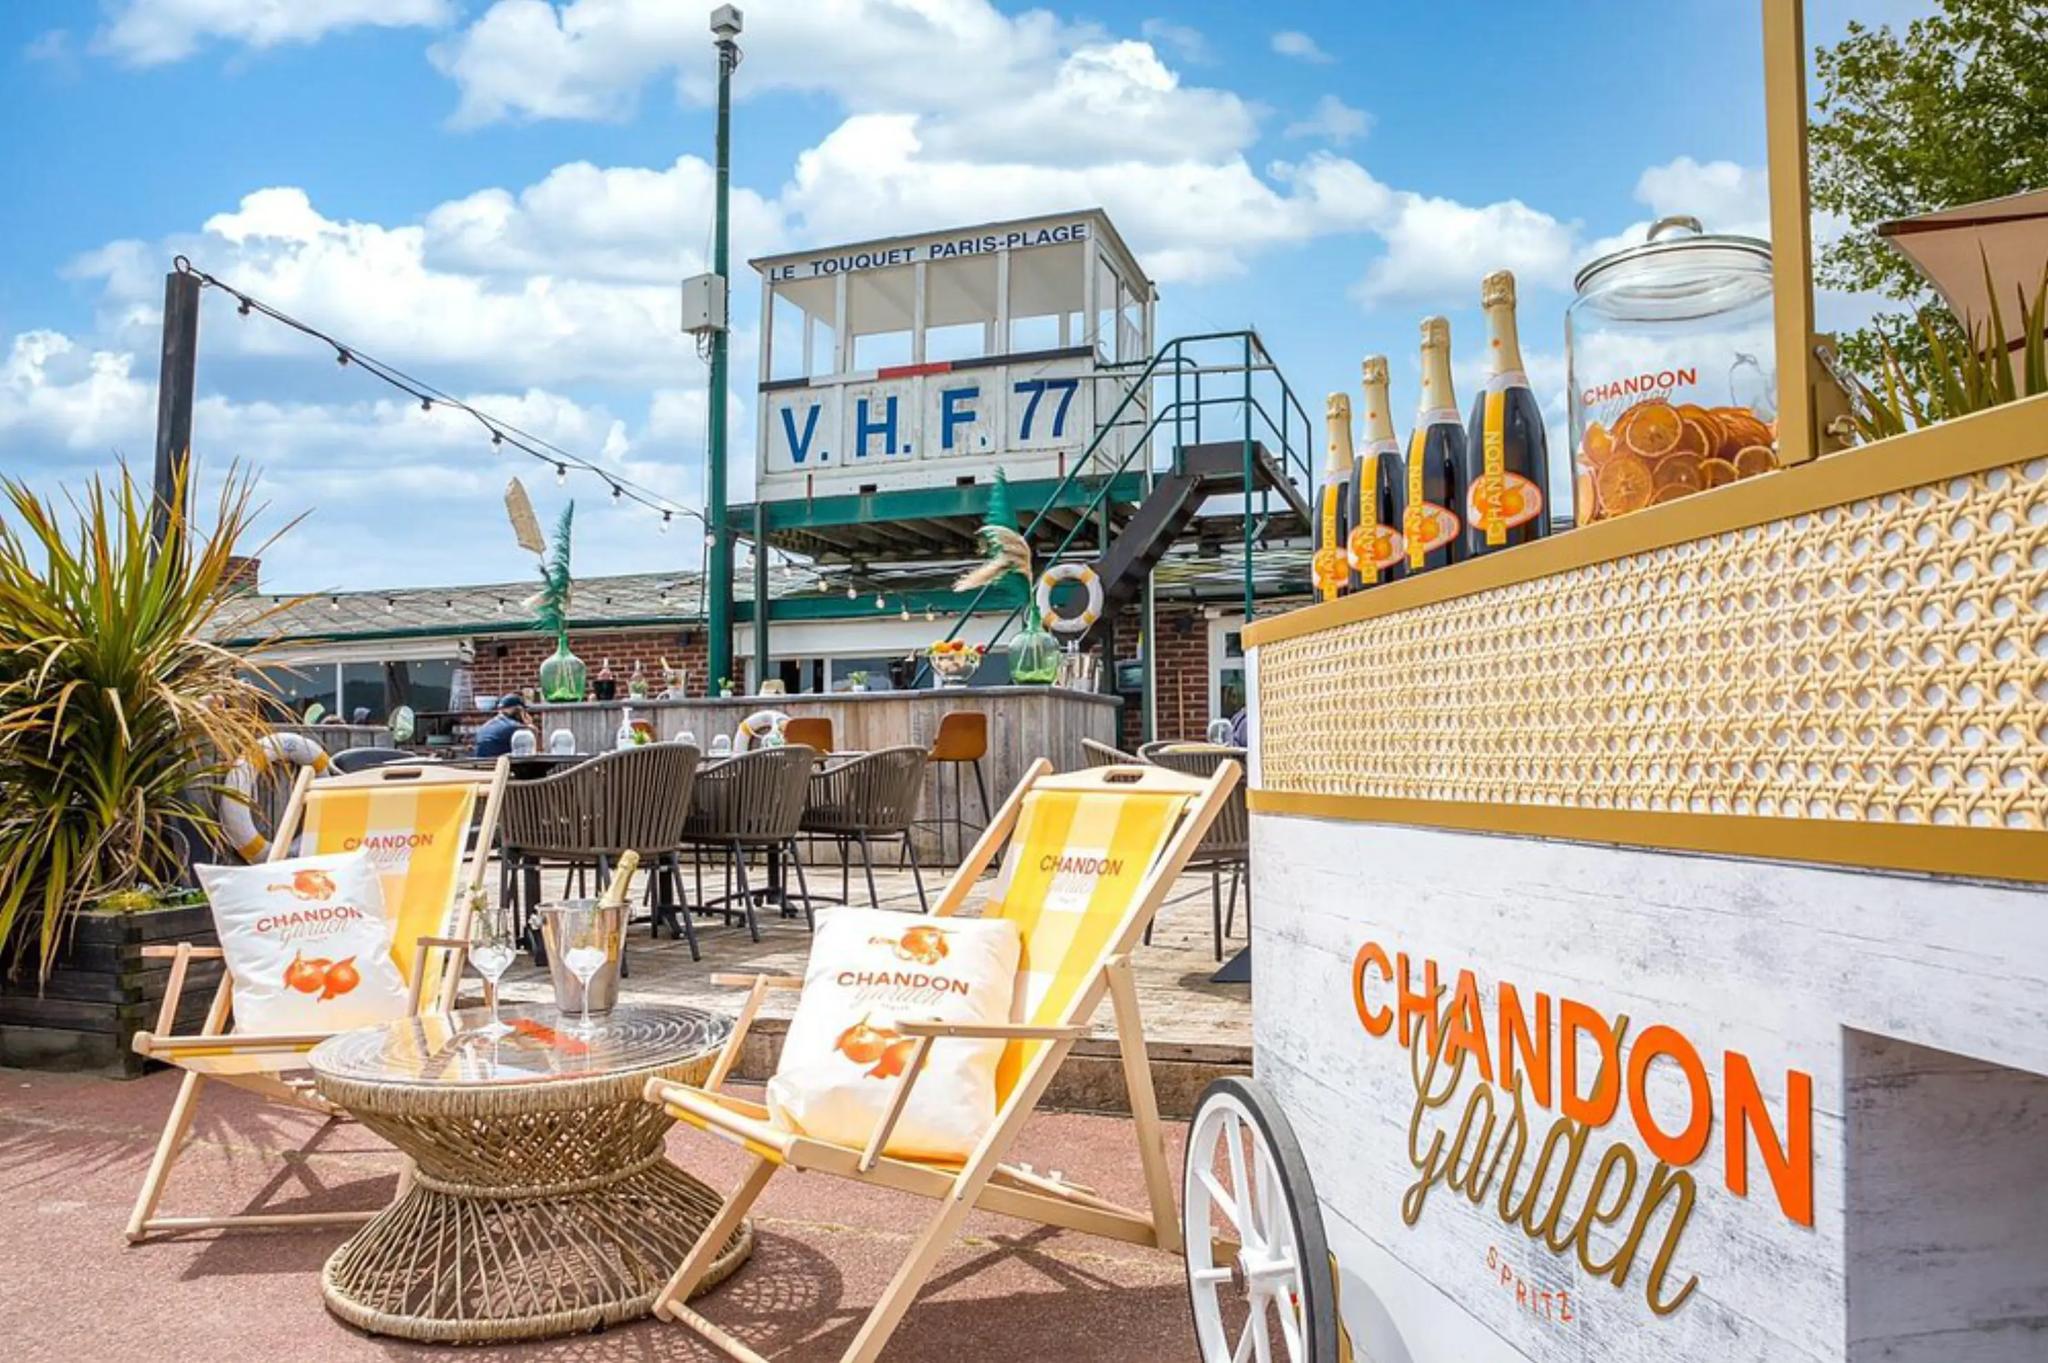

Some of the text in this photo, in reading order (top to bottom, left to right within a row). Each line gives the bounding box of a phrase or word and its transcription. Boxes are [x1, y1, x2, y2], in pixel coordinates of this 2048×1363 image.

[770, 223, 1086, 283] LE TOUQUET PARIS-PLAGE
[781, 404, 829, 465] V.
[856, 395, 911, 458] H.
[1013, 378, 1079, 441] 77
[1582, 367, 1697, 406] CHANDON
[1485, 431, 1505, 537] CHANDON
[1039, 854, 1124, 876] CHANDON
[837, 971, 969, 996] CHANDON
[1352, 941, 1814, 1228] CHANDON
[1402, 984, 1699, 1316] Garden
[1486, 1246, 1573, 1323] SPRITZ
